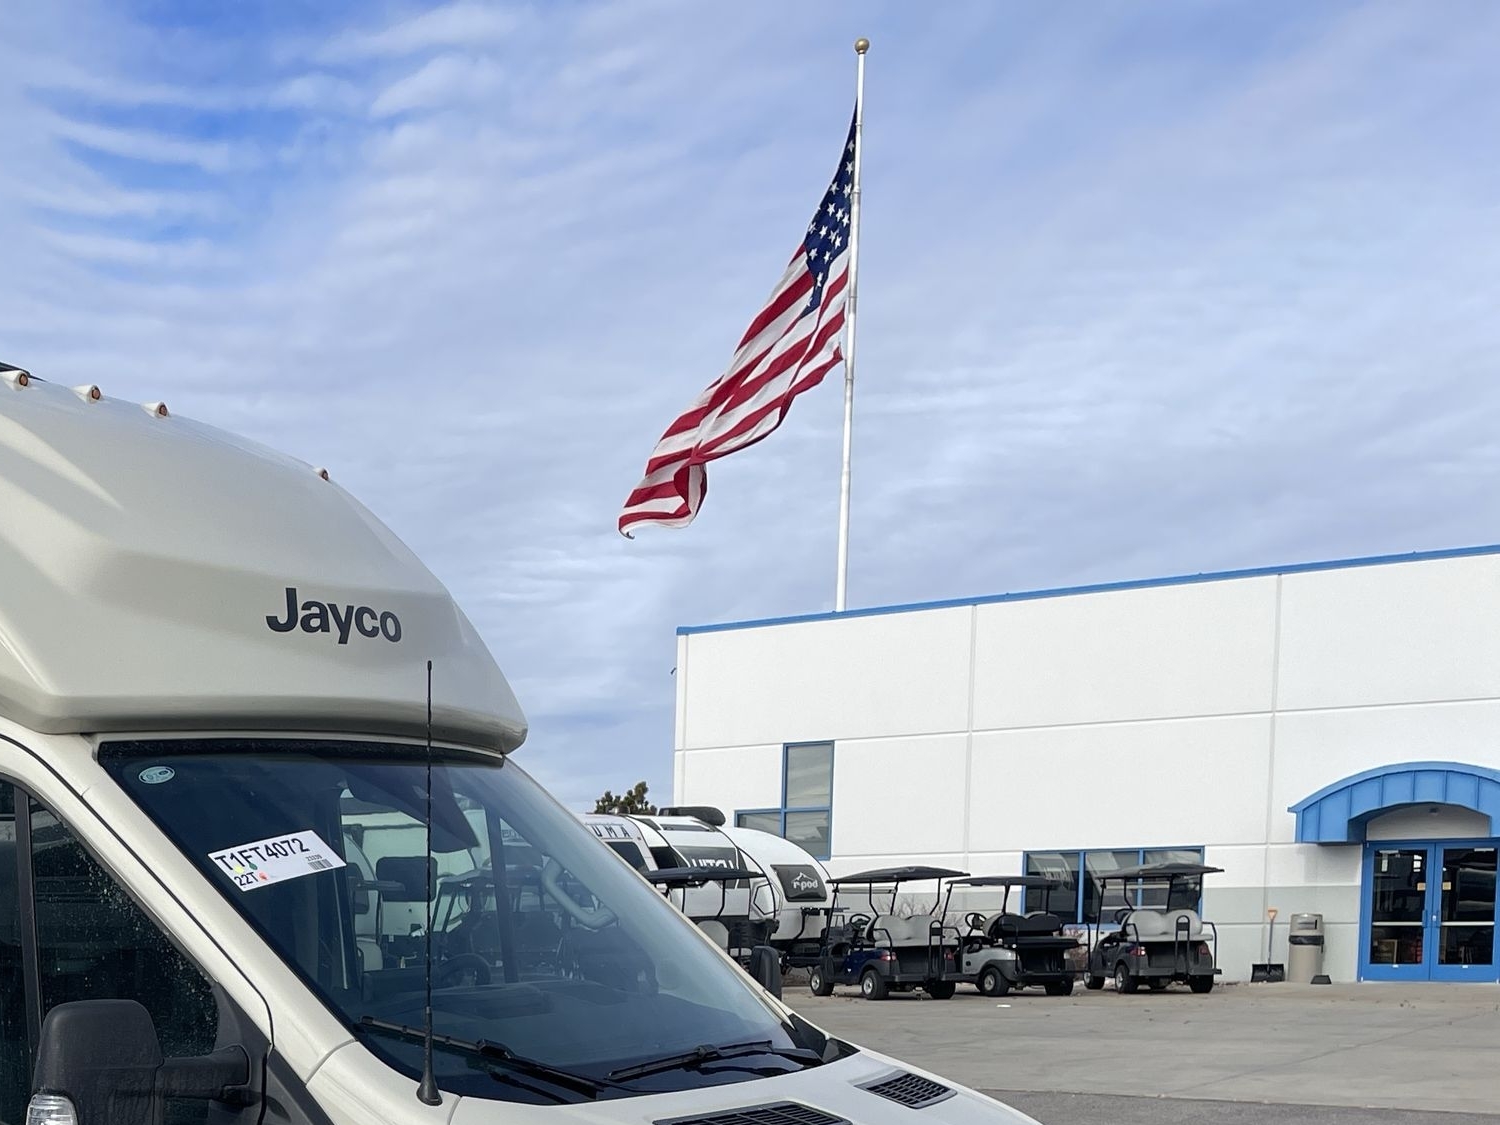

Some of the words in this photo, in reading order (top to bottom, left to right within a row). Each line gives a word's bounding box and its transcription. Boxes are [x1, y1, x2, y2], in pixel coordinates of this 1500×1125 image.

[265, 587, 402, 645] Jayco
[214, 838, 310, 871] T1FT4072
[234, 872, 259, 886] 22T
